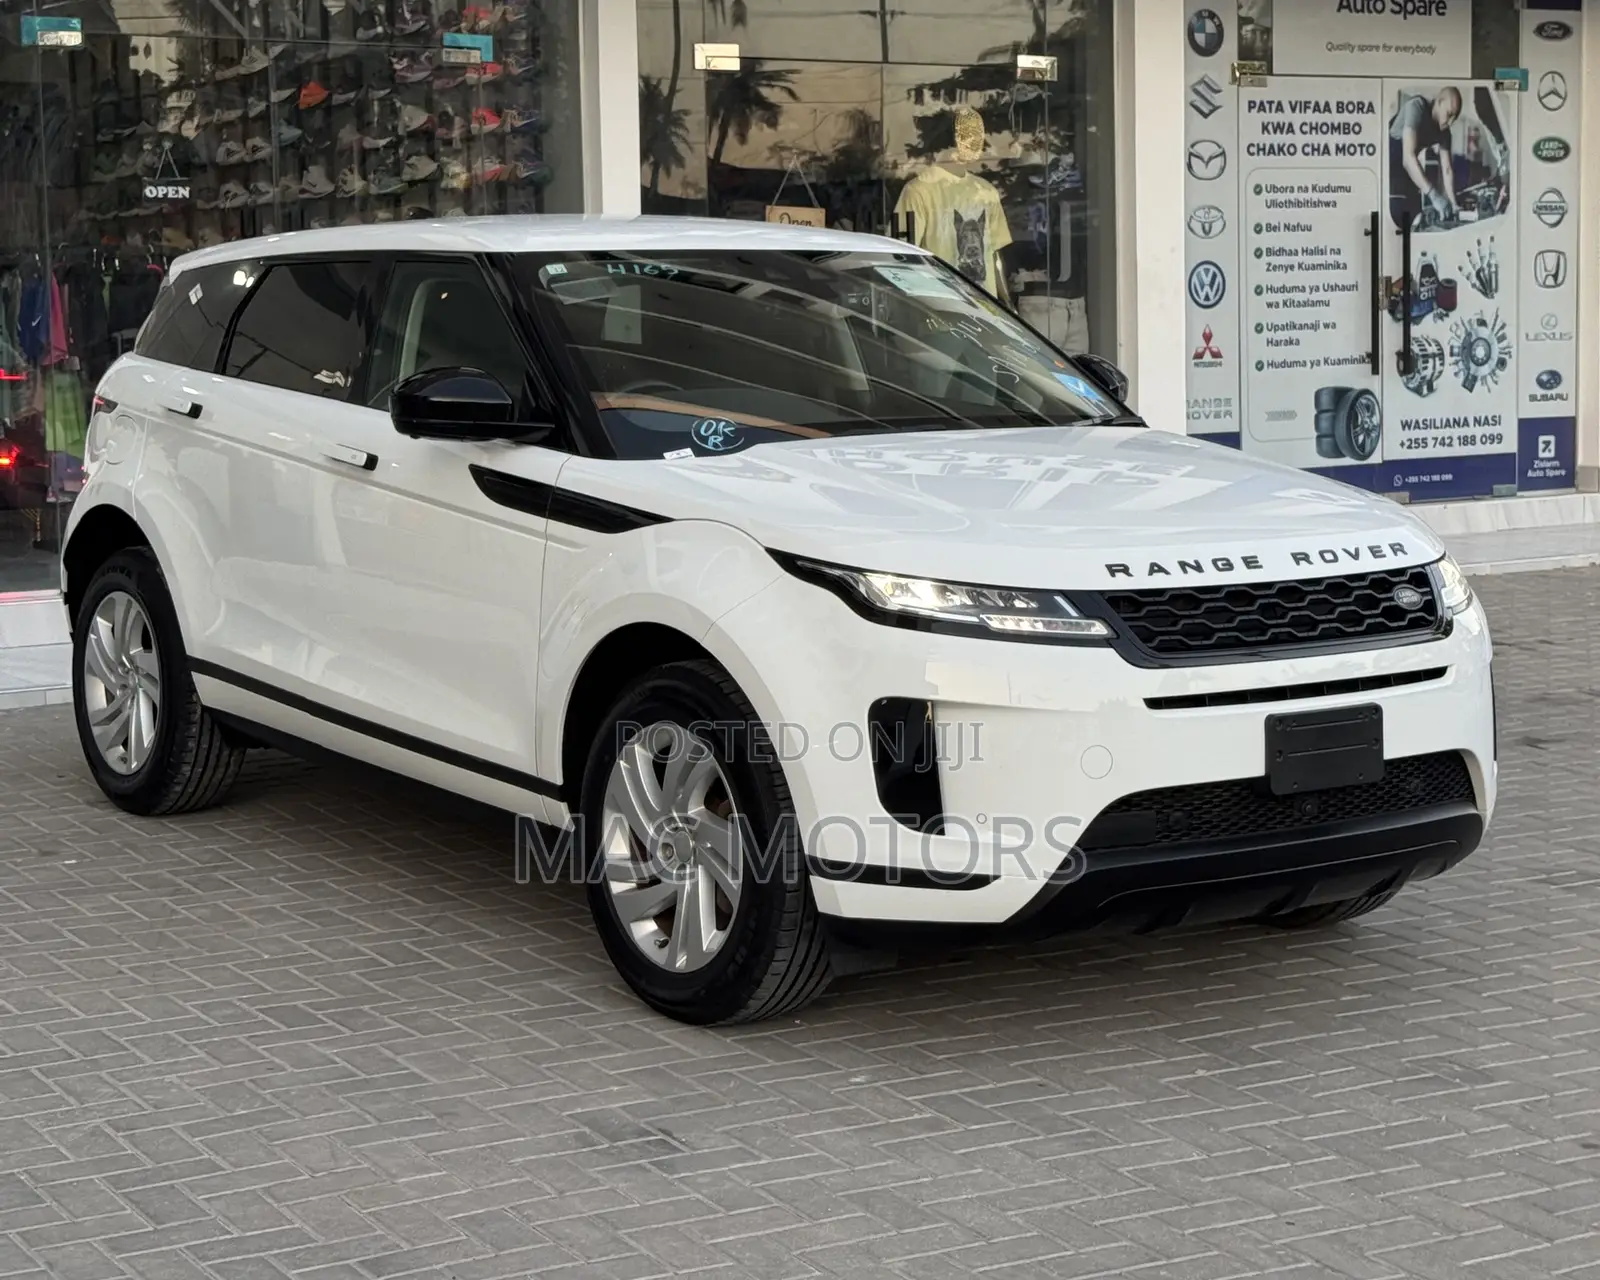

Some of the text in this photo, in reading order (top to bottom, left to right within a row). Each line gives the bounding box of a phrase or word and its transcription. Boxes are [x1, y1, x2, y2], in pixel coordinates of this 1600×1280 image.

[1337, 0, 1447, 20] Auto Spare
[1325, 41, 1436, 55] Quality spare for everybody
[1247, 101, 1376, 114] PATA VIFAA BORA
[1261, 122, 1362, 135] KWA CHOMBO
[1246, 143, 1376, 156] CHAKO CHA MOTO
[145, 185, 190, 199] OPEN
[1265, 184, 1352, 194] Ubora na Kudumu
[1265, 199, 1337, 209] Uliothibitishwa
[1265, 222, 1312, 233] Bei Nafuu
[1265, 247, 1299, 257] Bidhaa
[1301, 246, 1327, 256] Halisi
[1265, 260, 1348, 273] Zenye Kuaminika
[1266, 281, 1358, 294] Huduma ya Ushauri
[1266, 298, 1330, 309] wa Kitaalamu
[1266, 322, 1320, 335] Upatikanaji
[1266, 337, 1300, 347] Haraka
[1266, 358, 1307, 369] Huduma
[1310, 358, 1320, 369] ya
[700, 420, 736, 437] OK
[1400, 415, 1502, 431] WASILIANA NASI
[1399, 433, 1503, 449] +255 742 188 099
[1105, 541, 1408, 578] RANGE ROVER
